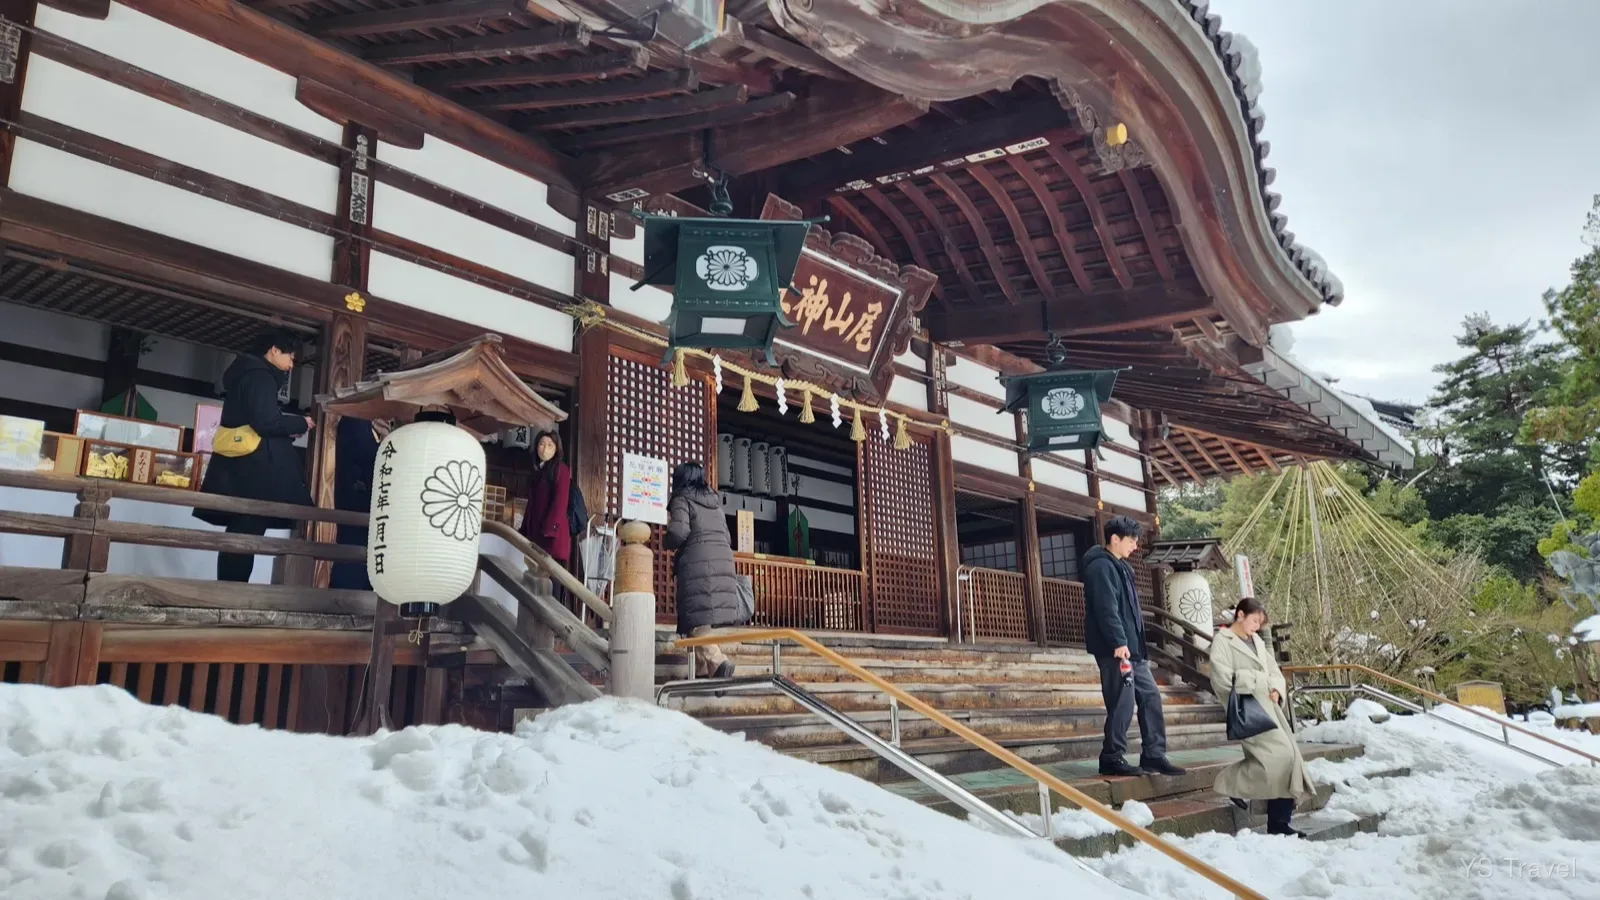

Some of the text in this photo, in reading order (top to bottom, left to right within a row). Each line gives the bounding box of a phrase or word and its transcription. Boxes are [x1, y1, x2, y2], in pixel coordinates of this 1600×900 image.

[138, 451, 147, 481] おみくじ
[374, 440, 397, 575] 令和七年一月一日
